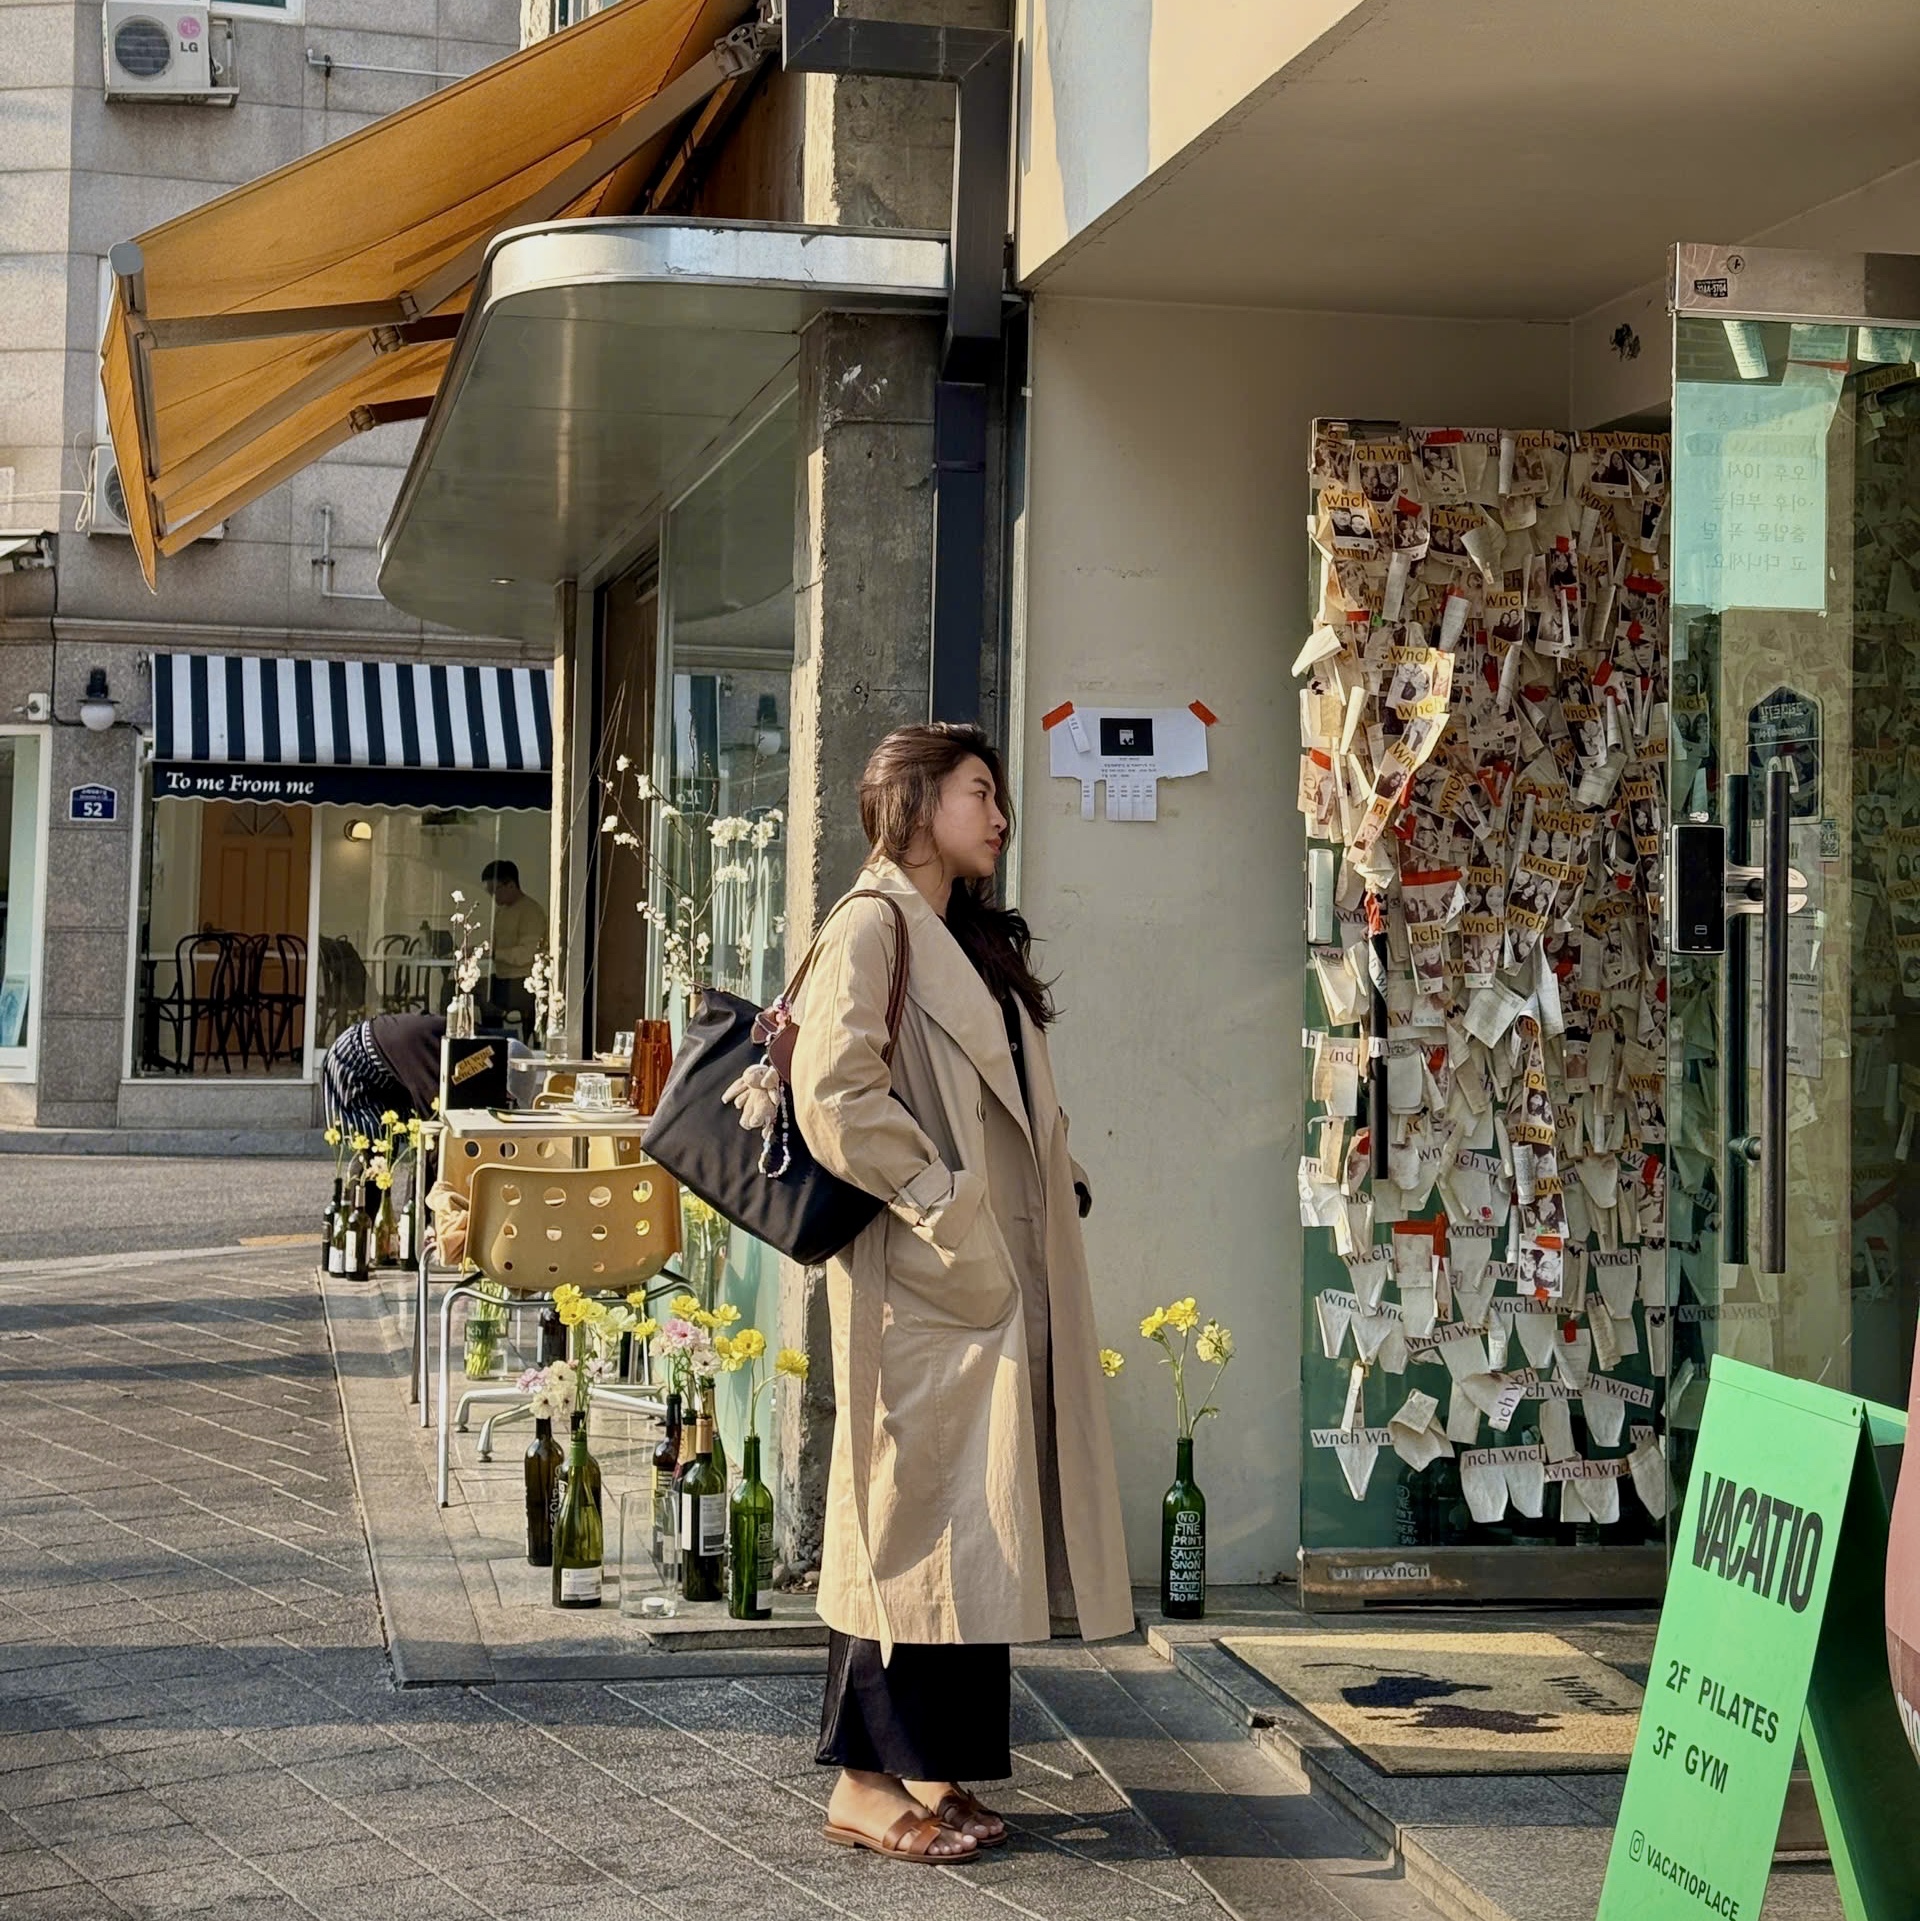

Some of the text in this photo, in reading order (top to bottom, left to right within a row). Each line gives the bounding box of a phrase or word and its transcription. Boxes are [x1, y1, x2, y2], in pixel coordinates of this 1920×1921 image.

[180, 41, 199, 53] LG
[1580, 433, 1601, 447] ch
[1615, 434, 1660, 449] Wnch
[1391, 648, 1433, 663] Wnch
[166, 771, 315, 795] To me From me
[83, 801, 103, 817] 52
[1535, 812, 1580, 833] Wnch
[1522, 855, 1568, 880] Wnch
[1461, 917, 1504, 934] Wnch
[1451, 1224, 1496, 1237] Wnch
[1490, 1297, 1533, 1314] Wnch
[1405, 1328, 1451, 1351] Wnch
[1606, 1379, 1650, 1405] Wnch
[1312, 1429, 1360, 1444] Wnch
[1179, 1514, 1196, 1523] NO
[1174, 1523, 1201, 1536] FINE
[1172, 1535, 1203, 1547] PRINT
[1692, 1471, 1824, 1614] VACATIO
[1171, 1560, 1201, 1570] GNON
[1169, 1569, 1201, 1581] BLANC
[1665, 1659, 1780, 1744] 2F PILATES
[1652, 1725, 1730, 1795] 3F GYM
[1646, 1844, 1740, 1921] VACATIOPLACE
